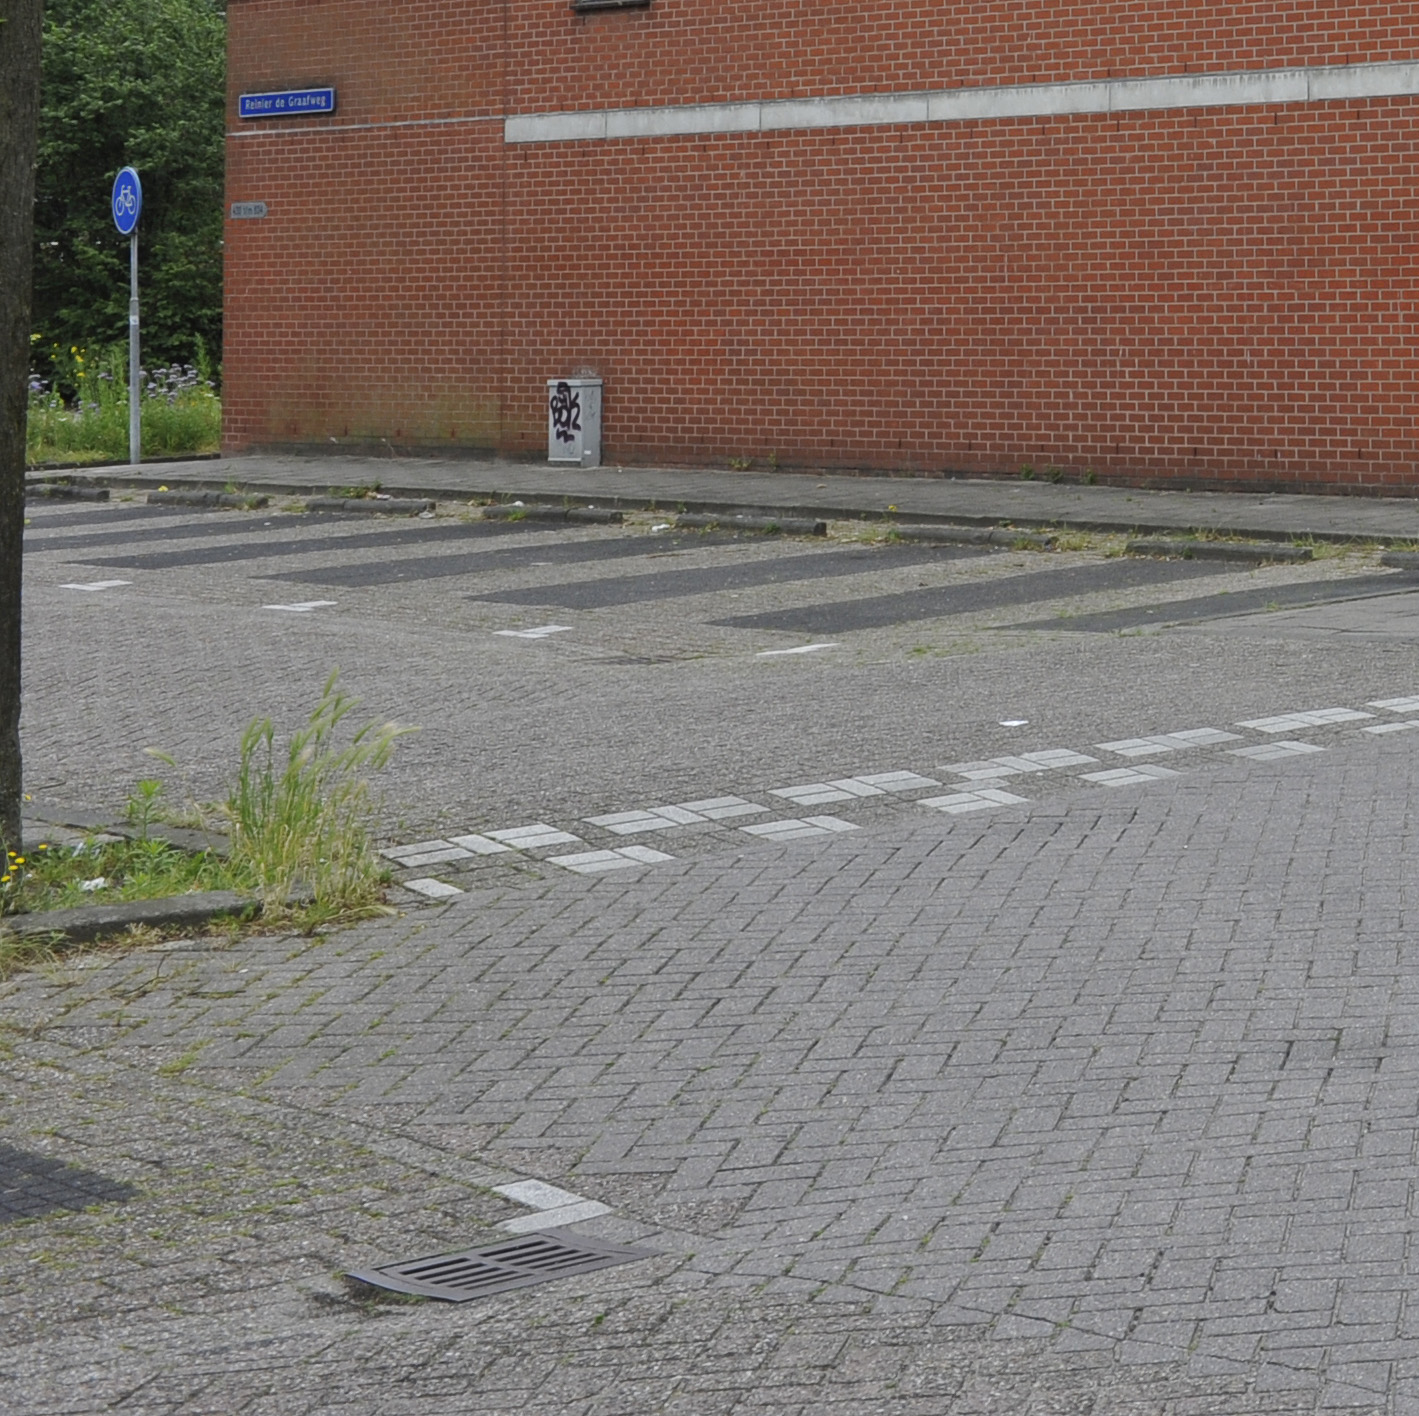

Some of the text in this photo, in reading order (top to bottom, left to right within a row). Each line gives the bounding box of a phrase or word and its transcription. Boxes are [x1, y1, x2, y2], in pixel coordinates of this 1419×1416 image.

[245, 94, 326, 110] Reinier de Graafweg
